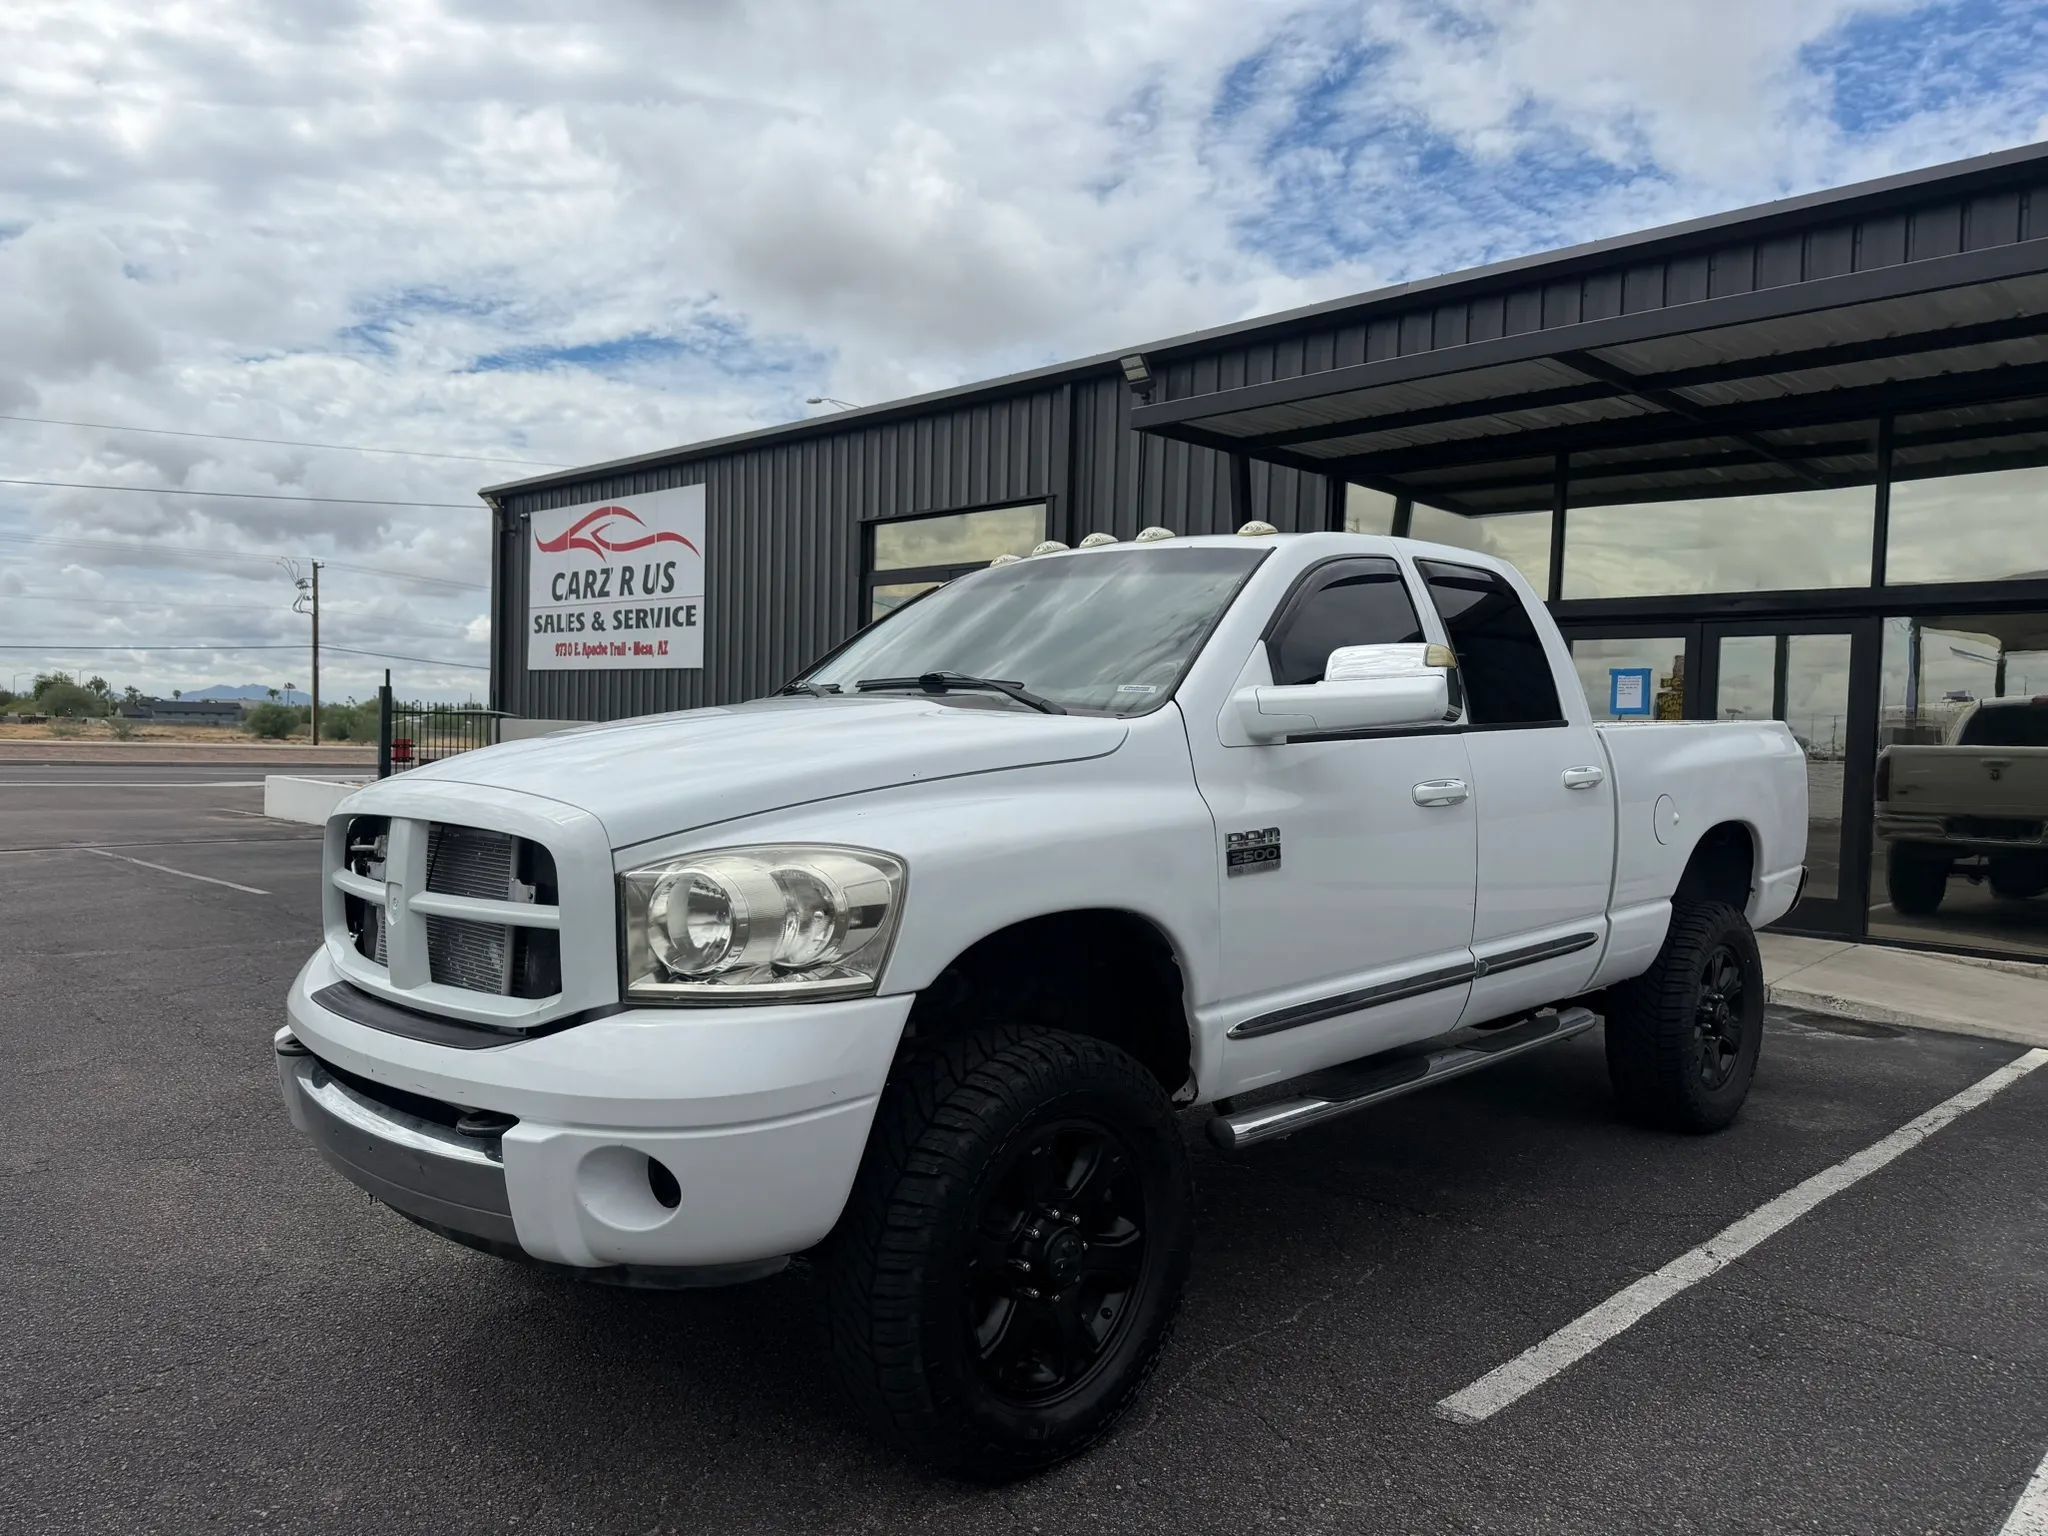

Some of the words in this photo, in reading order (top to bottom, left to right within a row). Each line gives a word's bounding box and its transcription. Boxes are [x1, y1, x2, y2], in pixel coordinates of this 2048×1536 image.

[619, 565, 635, 597] R
[642, 560, 677, 595] US
[534, 612, 585, 634] SALES
[591, 611, 606, 632] &
[612, 605, 697, 631] SERVICE
[555, 642, 573, 657] 9730
[582, 641, 608, 659] Apache
[609, 641, 627, 656] Trail
[657, 640, 669, 656] AZ
[1230, 847, 1278, 865] 2500
